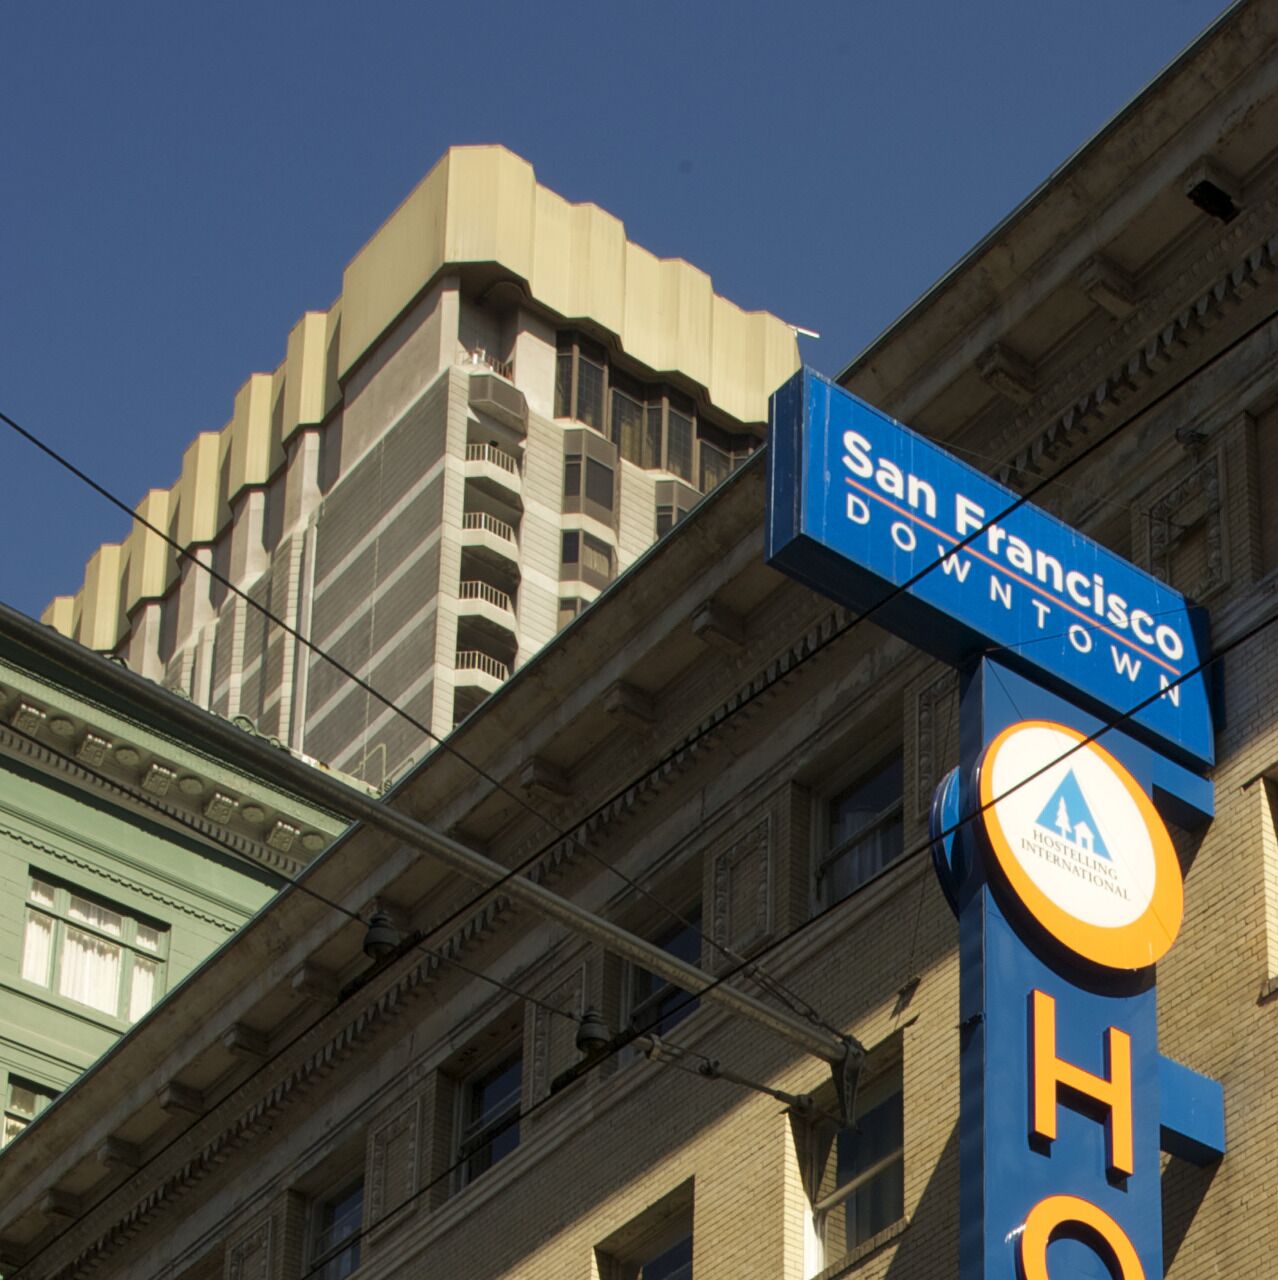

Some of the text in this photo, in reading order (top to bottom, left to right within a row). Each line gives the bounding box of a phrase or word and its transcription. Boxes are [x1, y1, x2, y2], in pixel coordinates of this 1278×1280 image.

[842, 429, 1183, 661] San Francisco
[847, 494, 1180, 707] DOWNTOWN
[1021, 837, 1131, 901] INTERNATIONAL
[1033, 829, 1118, 881] HOSTELLING
